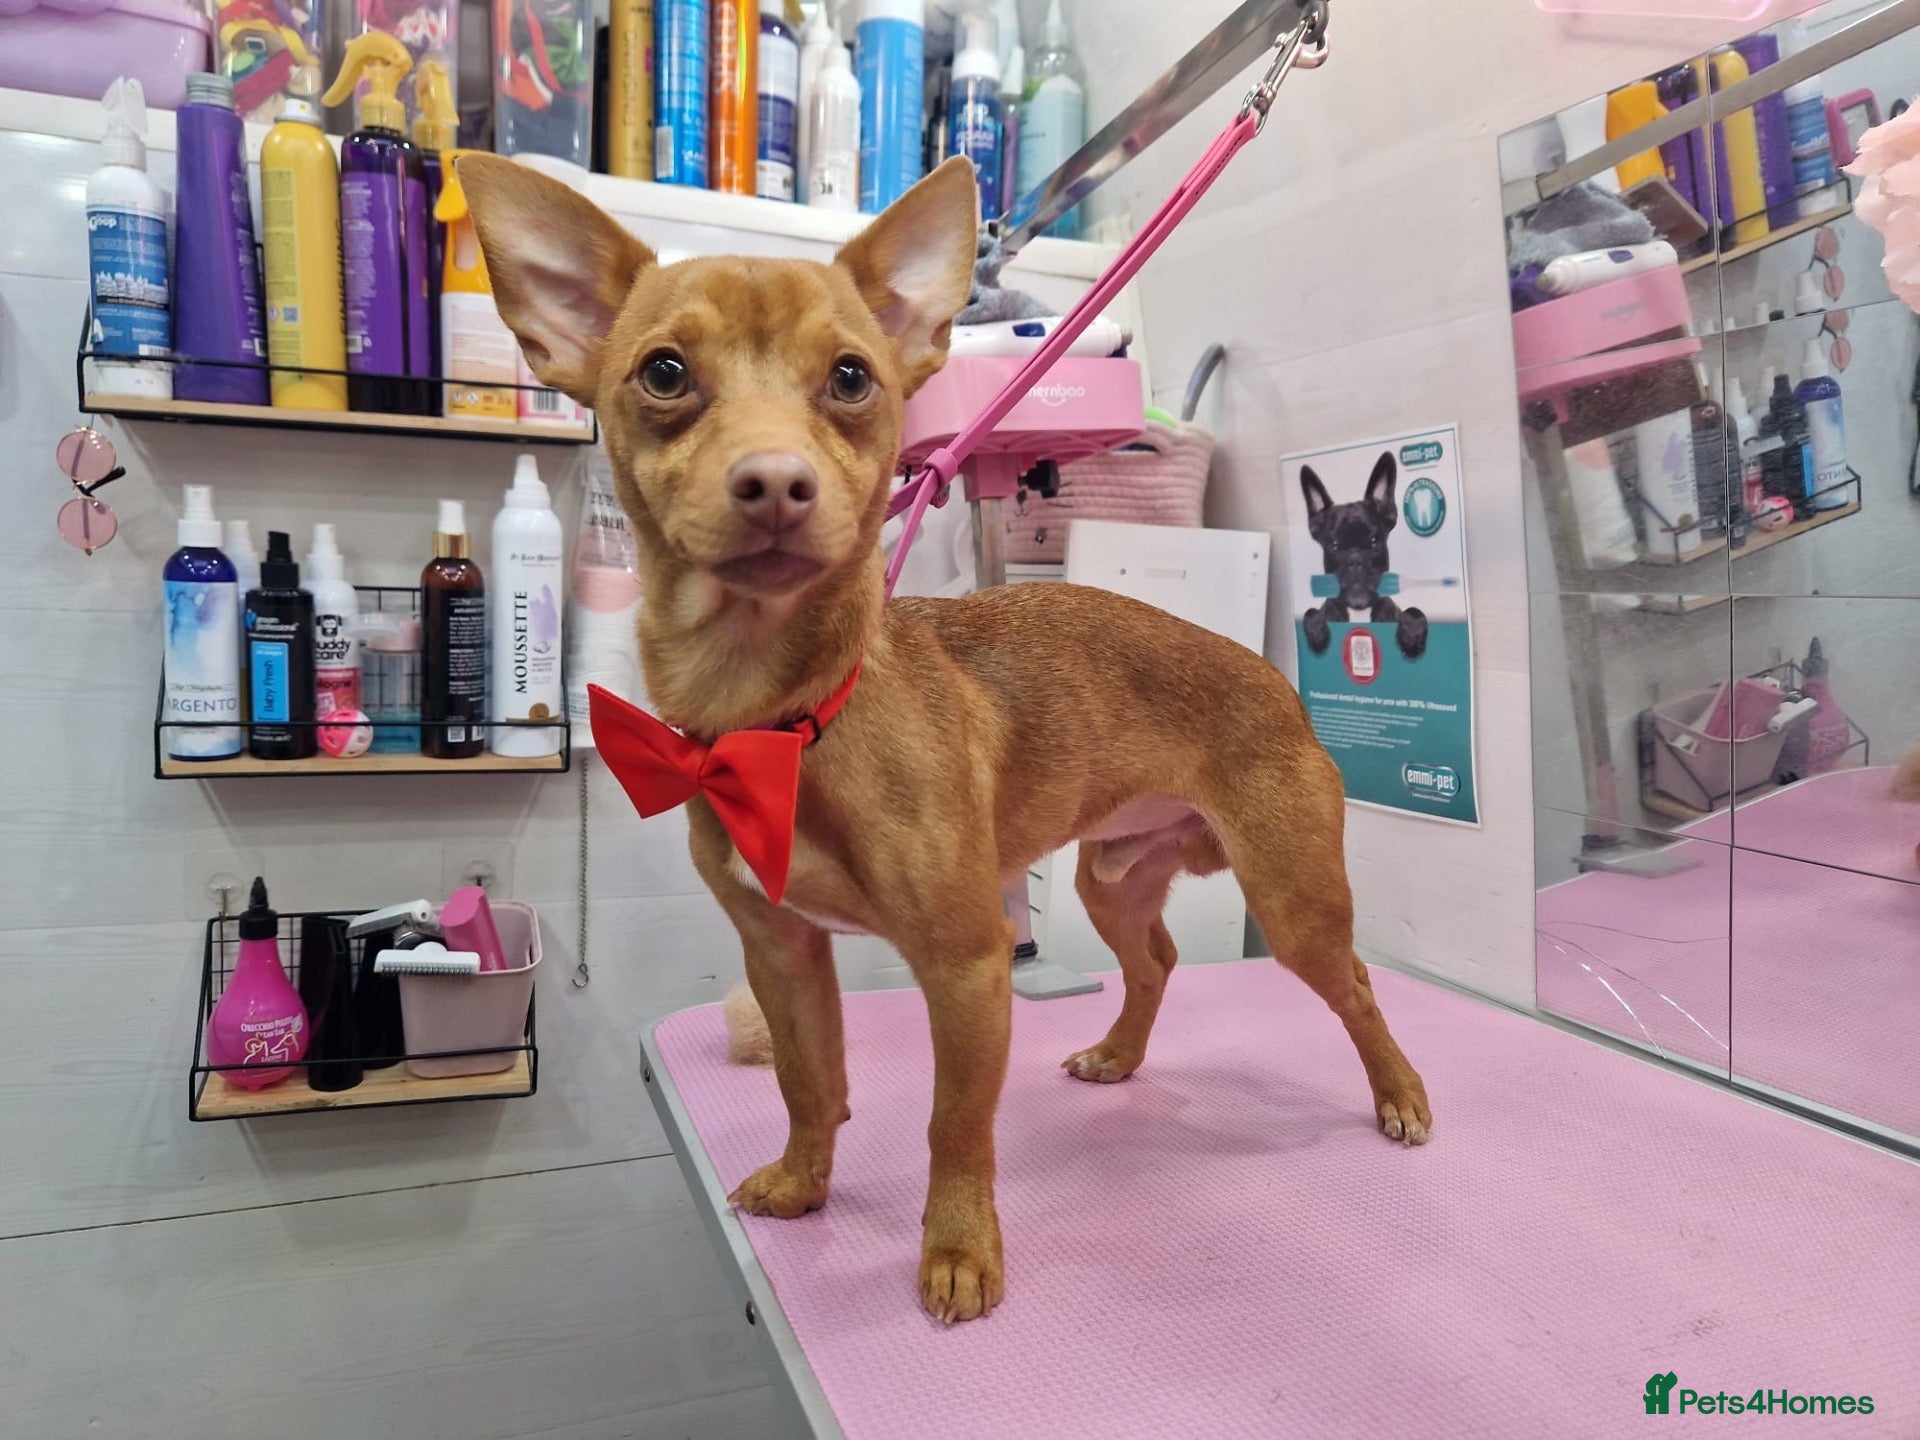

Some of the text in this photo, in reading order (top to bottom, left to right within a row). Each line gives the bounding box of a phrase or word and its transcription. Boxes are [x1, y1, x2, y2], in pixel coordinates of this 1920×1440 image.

[1028, 384, 1086, 397] hernbao
[514, 591, 528, 694] MOUSSETTE
[1407, 769, 1455, 790] emmi-pet
